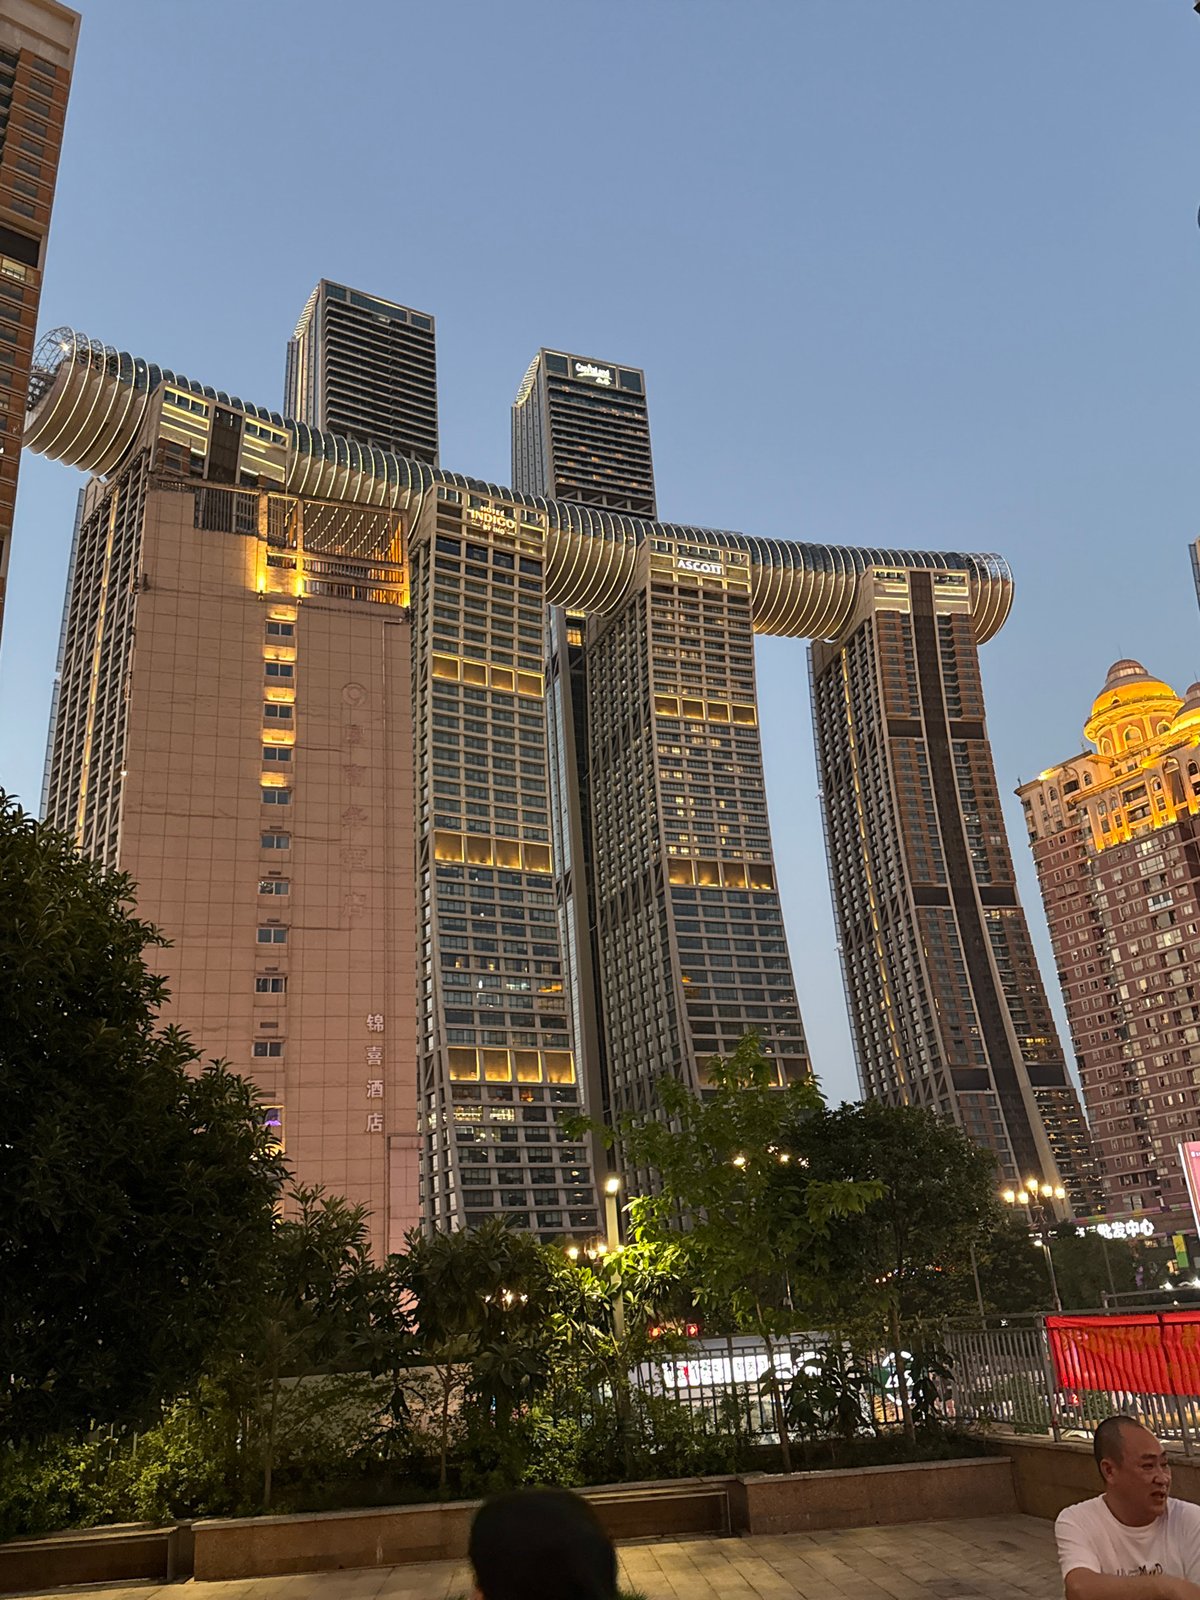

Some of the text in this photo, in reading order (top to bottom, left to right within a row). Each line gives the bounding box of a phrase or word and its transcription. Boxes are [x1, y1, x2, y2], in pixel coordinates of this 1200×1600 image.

[470, 509, 515, 529] INDIGO
[480, 505, 505, 516] HOTEL
[677, 559, 722, 575] ASCOTT
[366, 1013, 385, 1132] 锦喜酒店
